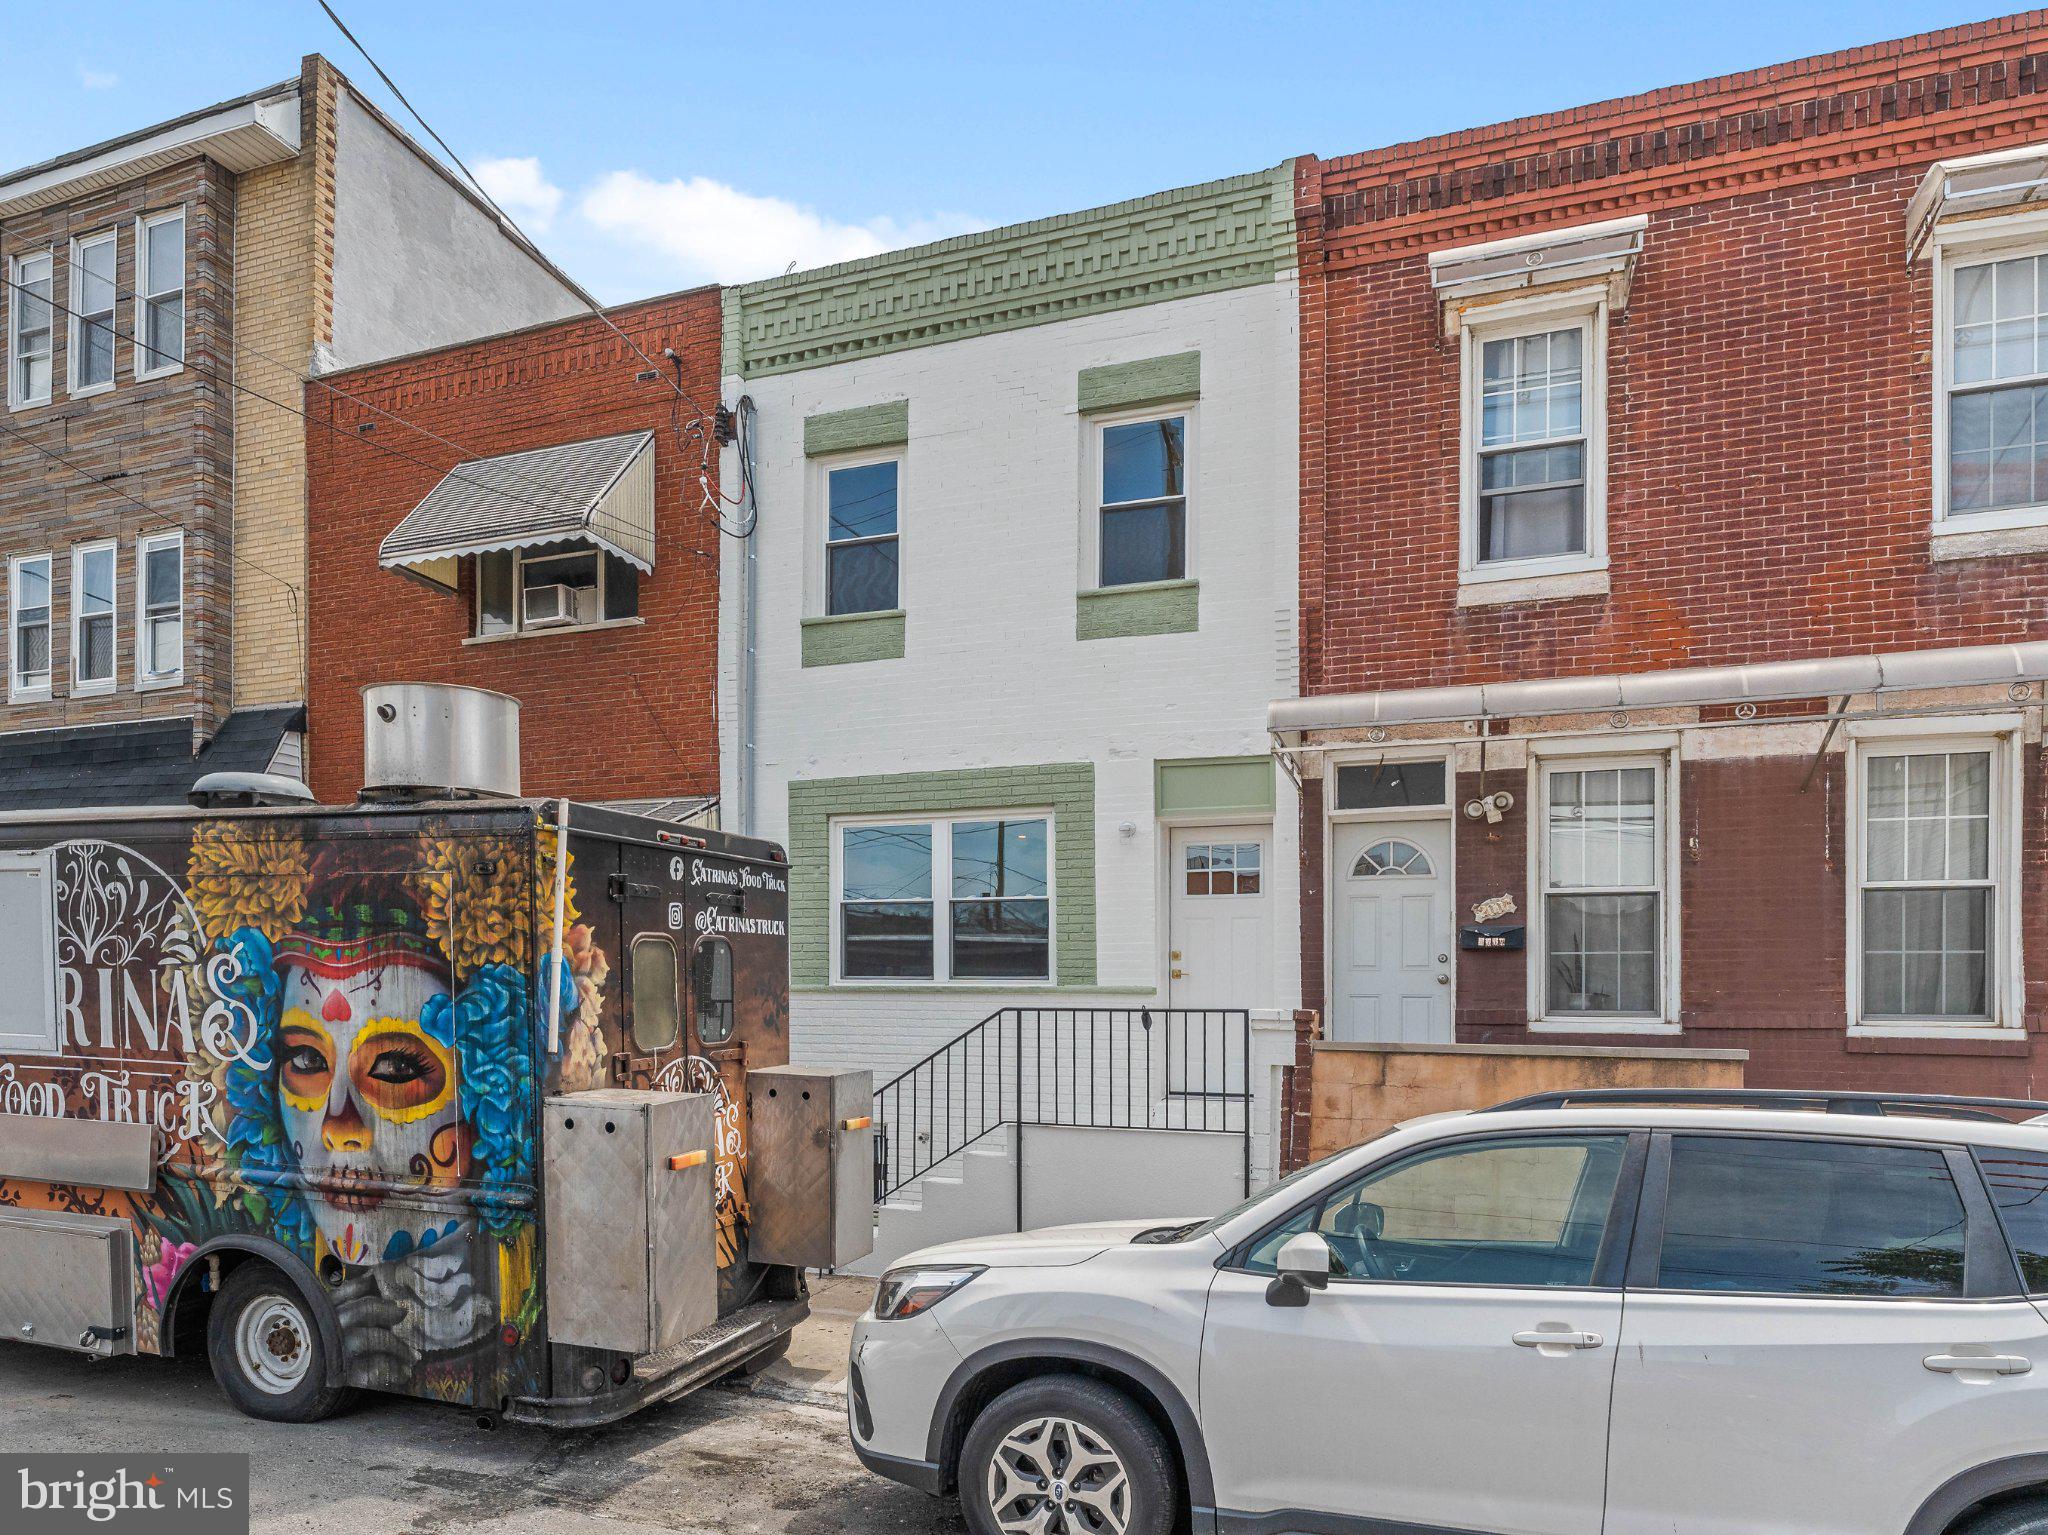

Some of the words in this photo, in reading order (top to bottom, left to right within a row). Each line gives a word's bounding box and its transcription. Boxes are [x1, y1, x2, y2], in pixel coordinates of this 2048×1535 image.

[739, 866, 762, 888] FOOD
[762, 872, 786, 892] TRUCK
[695, 907, 785, 935] @CATRINASTRUCK
[60, 942, 272, 1071] RINA'S
[80, 1070, 229, 1144] TRUCK
